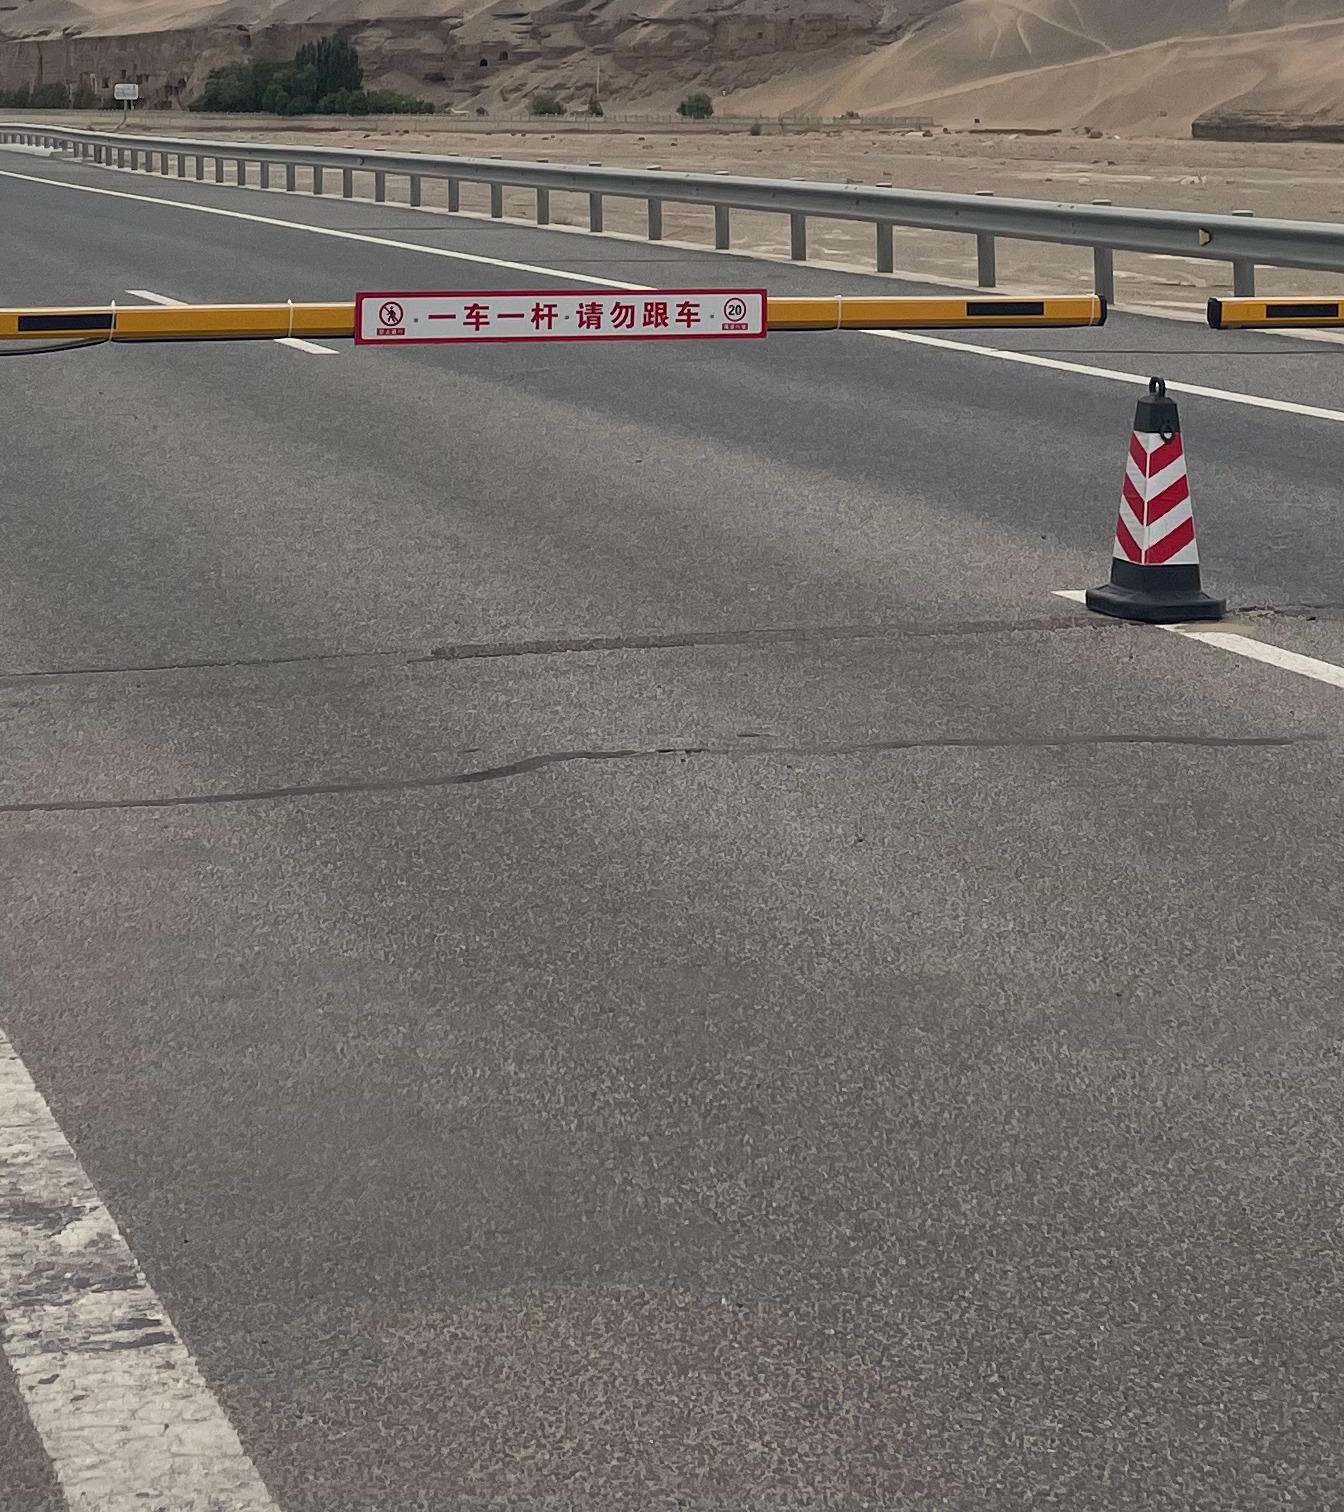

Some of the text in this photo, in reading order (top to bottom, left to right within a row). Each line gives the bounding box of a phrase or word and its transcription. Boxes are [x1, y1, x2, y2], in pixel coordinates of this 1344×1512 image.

[428, 300, 701, 331] 一车一杆 请勿跟车
[728, 304, 742, 316] 20
